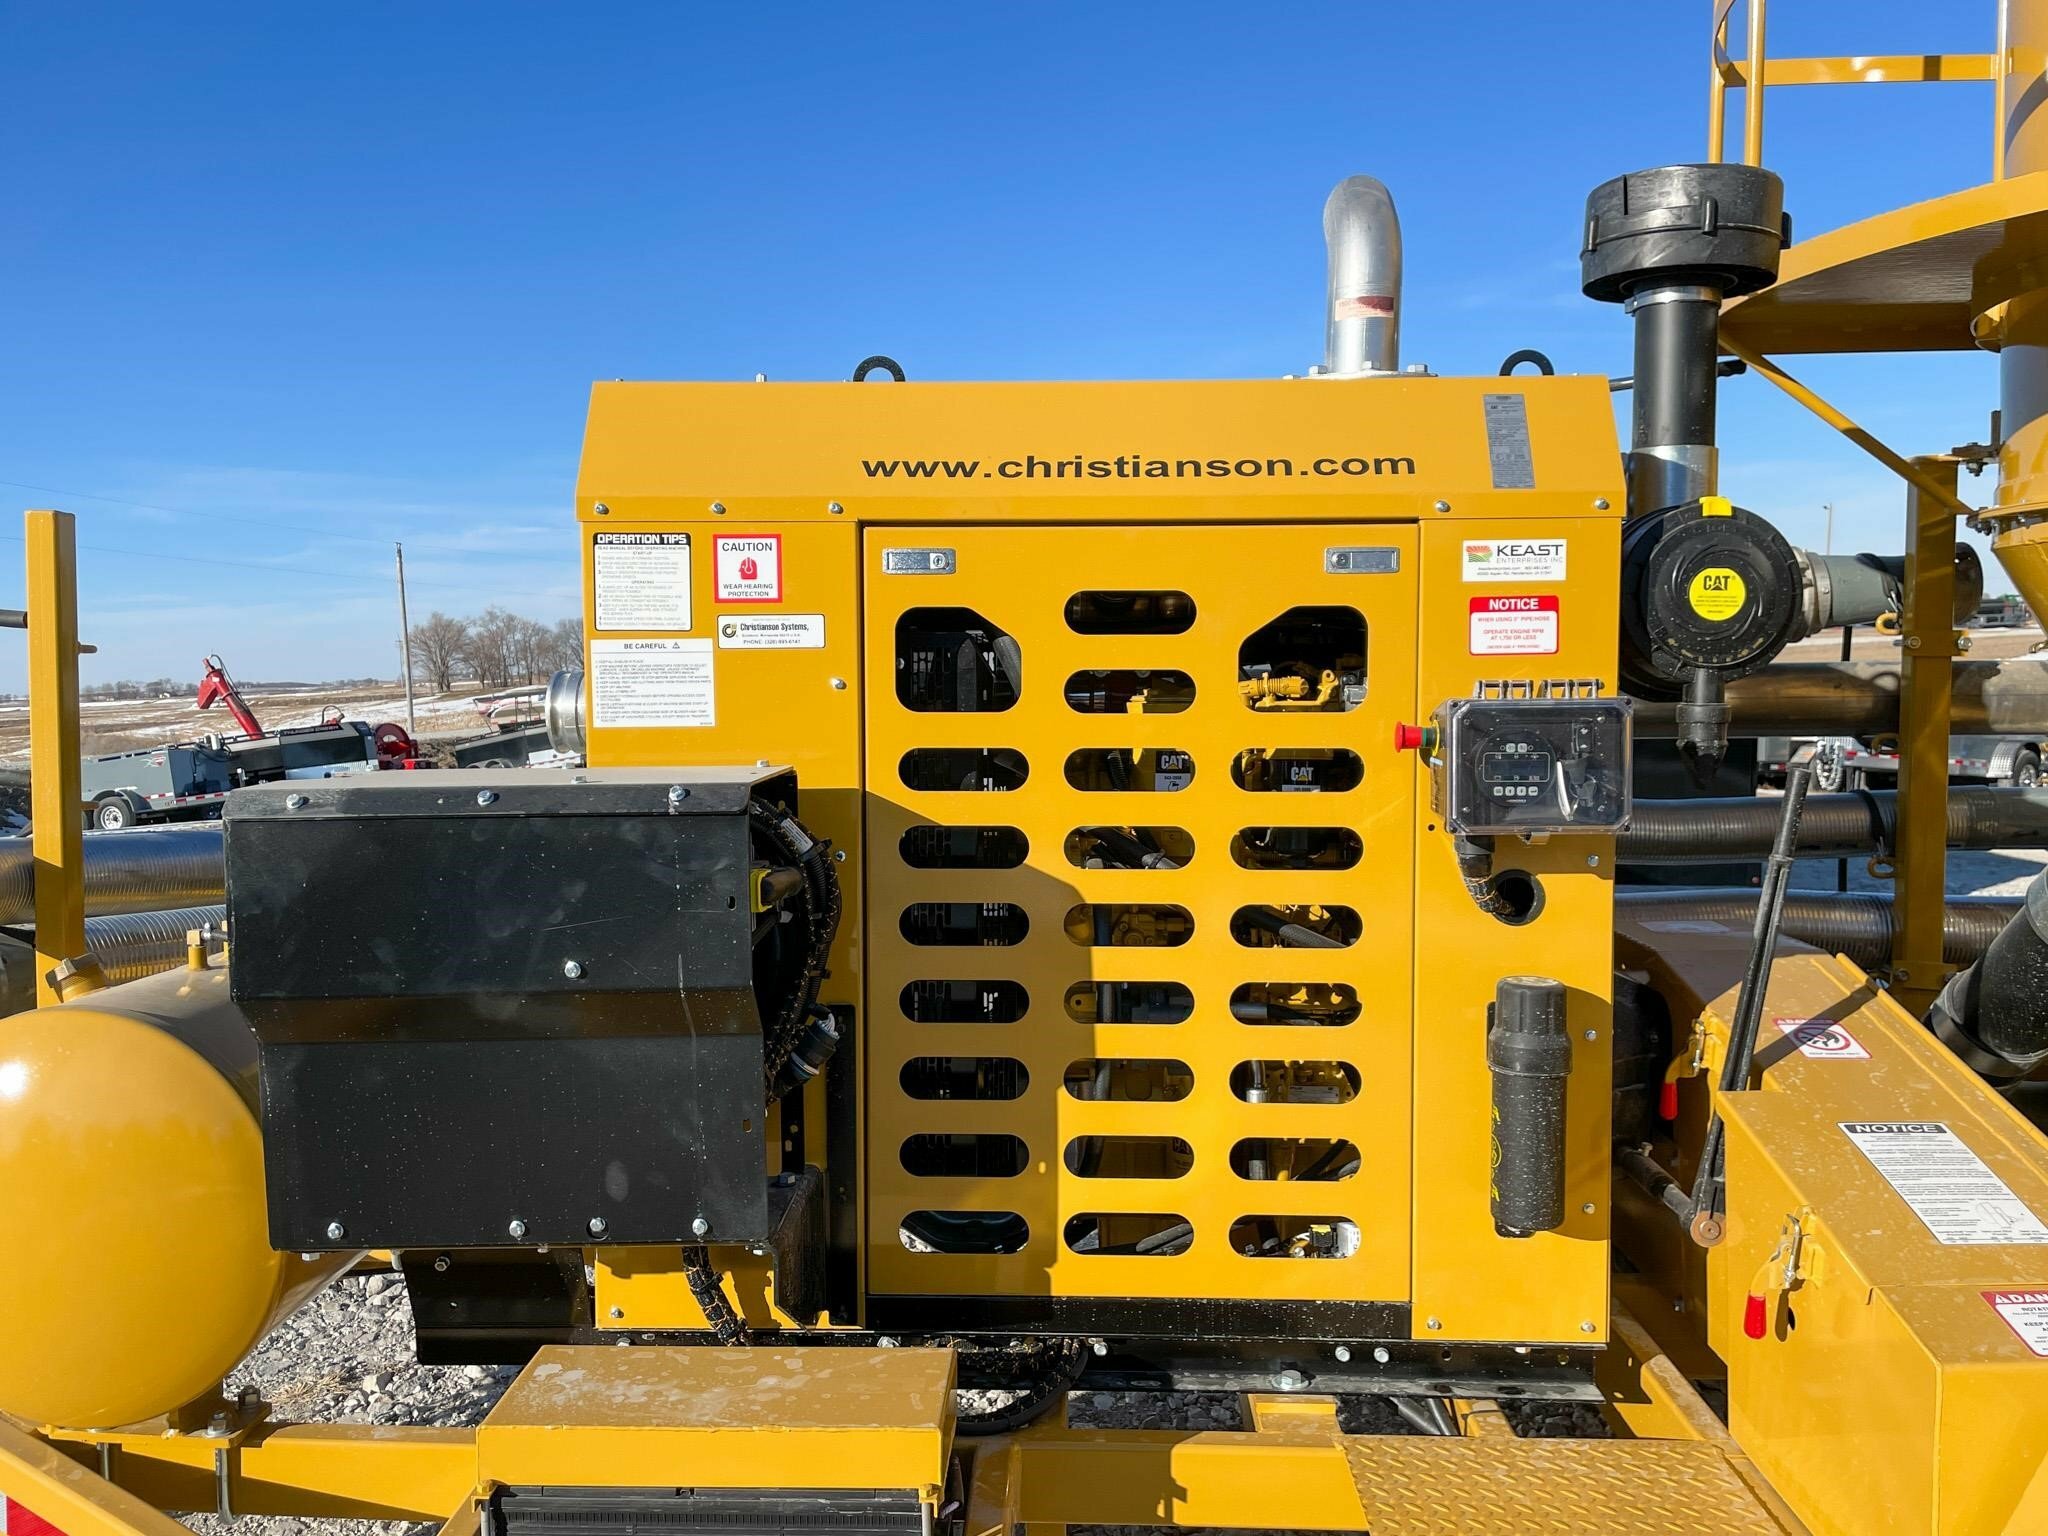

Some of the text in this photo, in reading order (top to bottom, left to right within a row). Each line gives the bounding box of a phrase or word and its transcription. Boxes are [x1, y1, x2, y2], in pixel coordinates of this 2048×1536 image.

[860, 453, 1417, 480] www.christianson.com
[596, 533, 687, 544] OPERATION TIPS
[721, 542, 773, 552] CAUTION
[1496, 544, 1564, 557] KEAST
[1496, 556, 1548, 564] ENTERPRISES
[1703, 574, 1731, 591] CAT
[1488, 597, 1540, 611] NOTICE
[740, 622, 780, 631] Christianson
[1160, 754, 1184, 770] CAT
[1290, 766, 1315, 782] CAT
[1854, 1123, 1939, 1134] NOTICE
